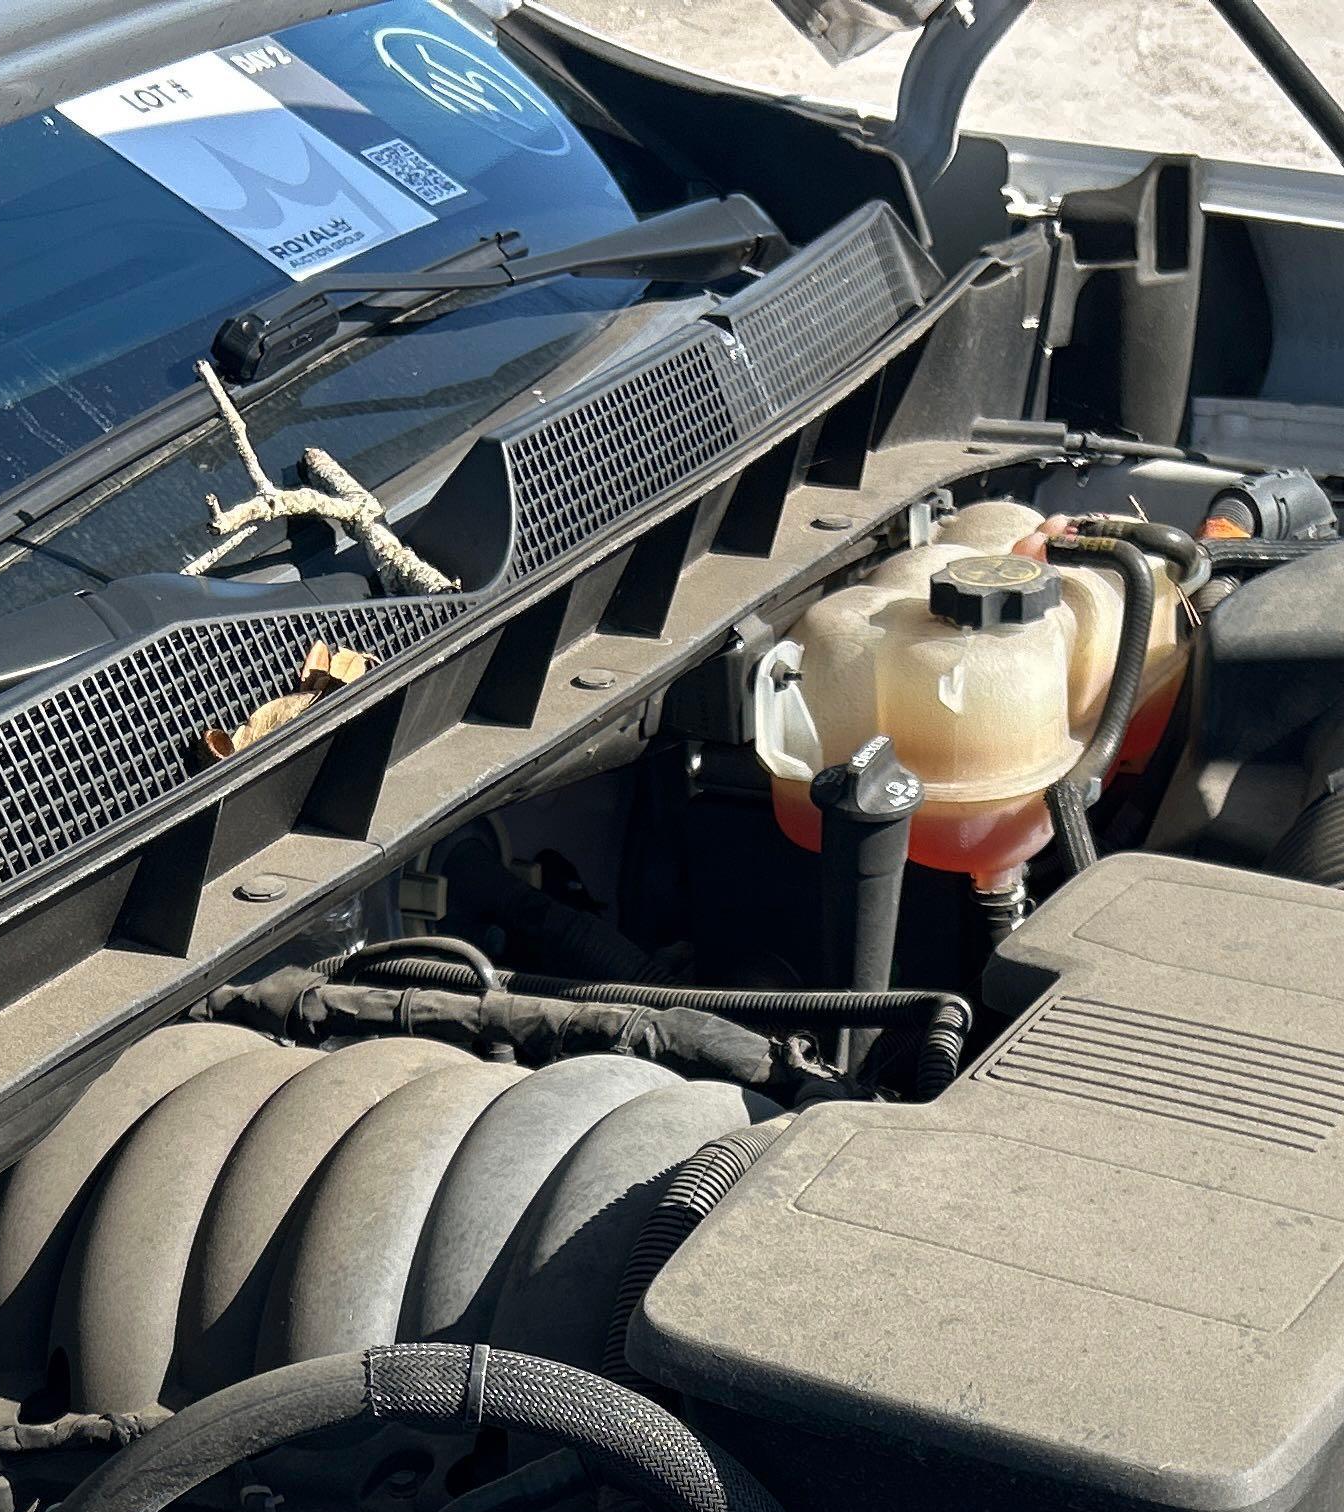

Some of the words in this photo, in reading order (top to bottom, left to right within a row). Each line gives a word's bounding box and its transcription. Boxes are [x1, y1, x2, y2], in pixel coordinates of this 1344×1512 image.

[229, 48, 276, 75] DAY
[265, 46, 292, 65] 2
[119, 84, 177, 113] LOT
[166, 79, 194, 99] #
[268, 226, 339, 260] ROYAL
